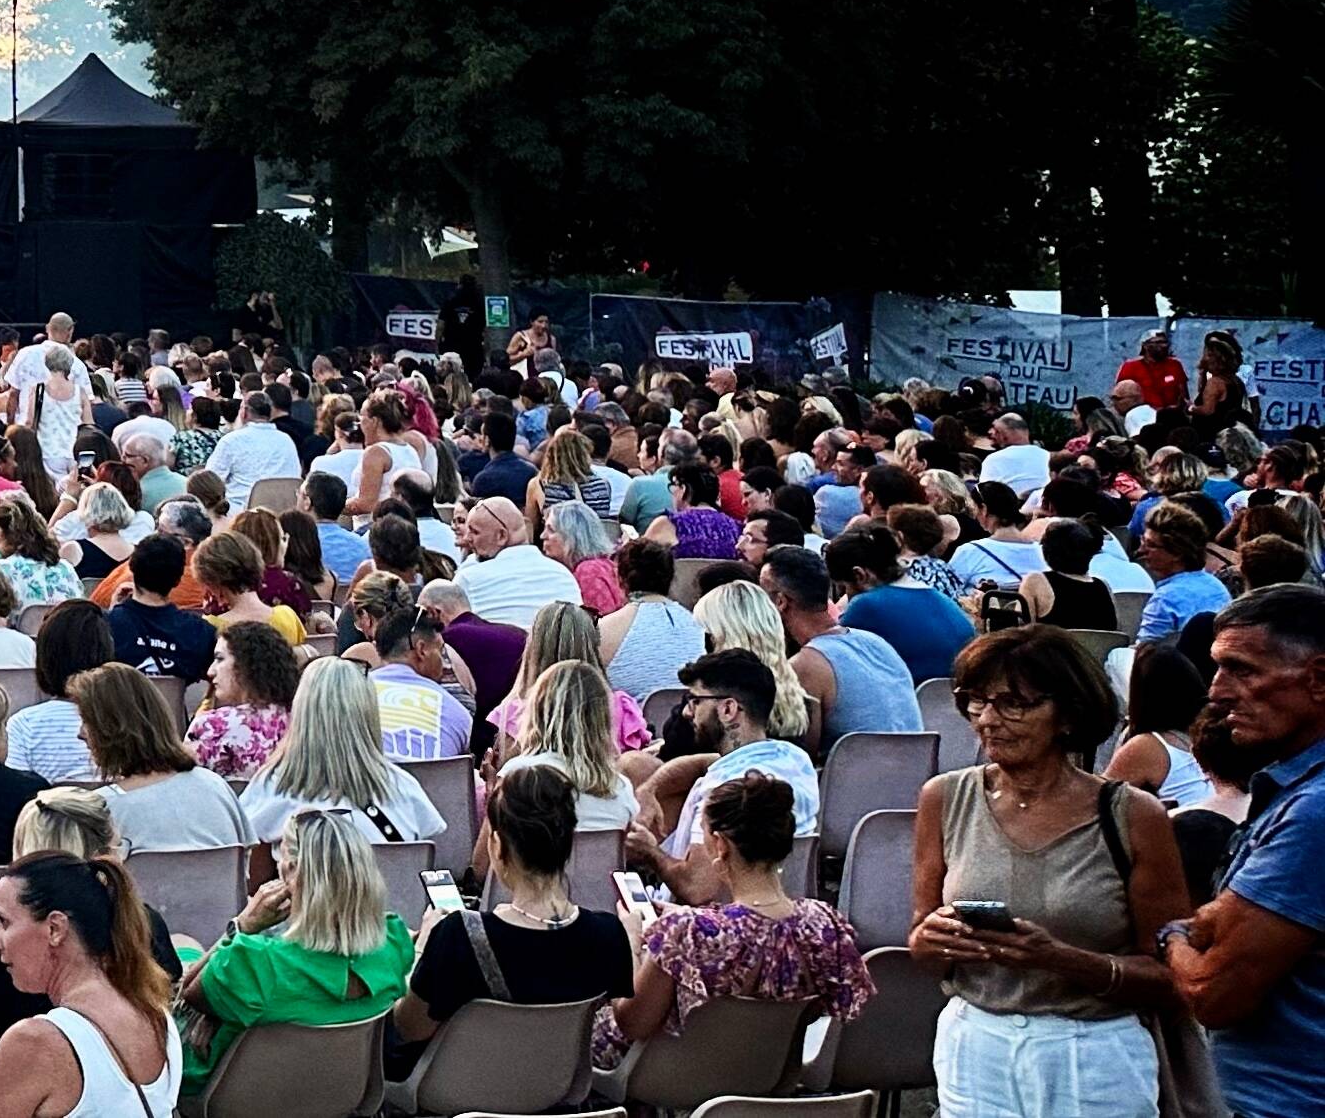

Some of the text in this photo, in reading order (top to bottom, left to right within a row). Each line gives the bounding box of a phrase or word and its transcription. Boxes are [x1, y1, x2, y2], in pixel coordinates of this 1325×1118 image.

[947, 338, 1065, 367] FESTIVAL
[1010, 366, 1034, 380] DU
[1266, 401, 1325, 426] CHA
